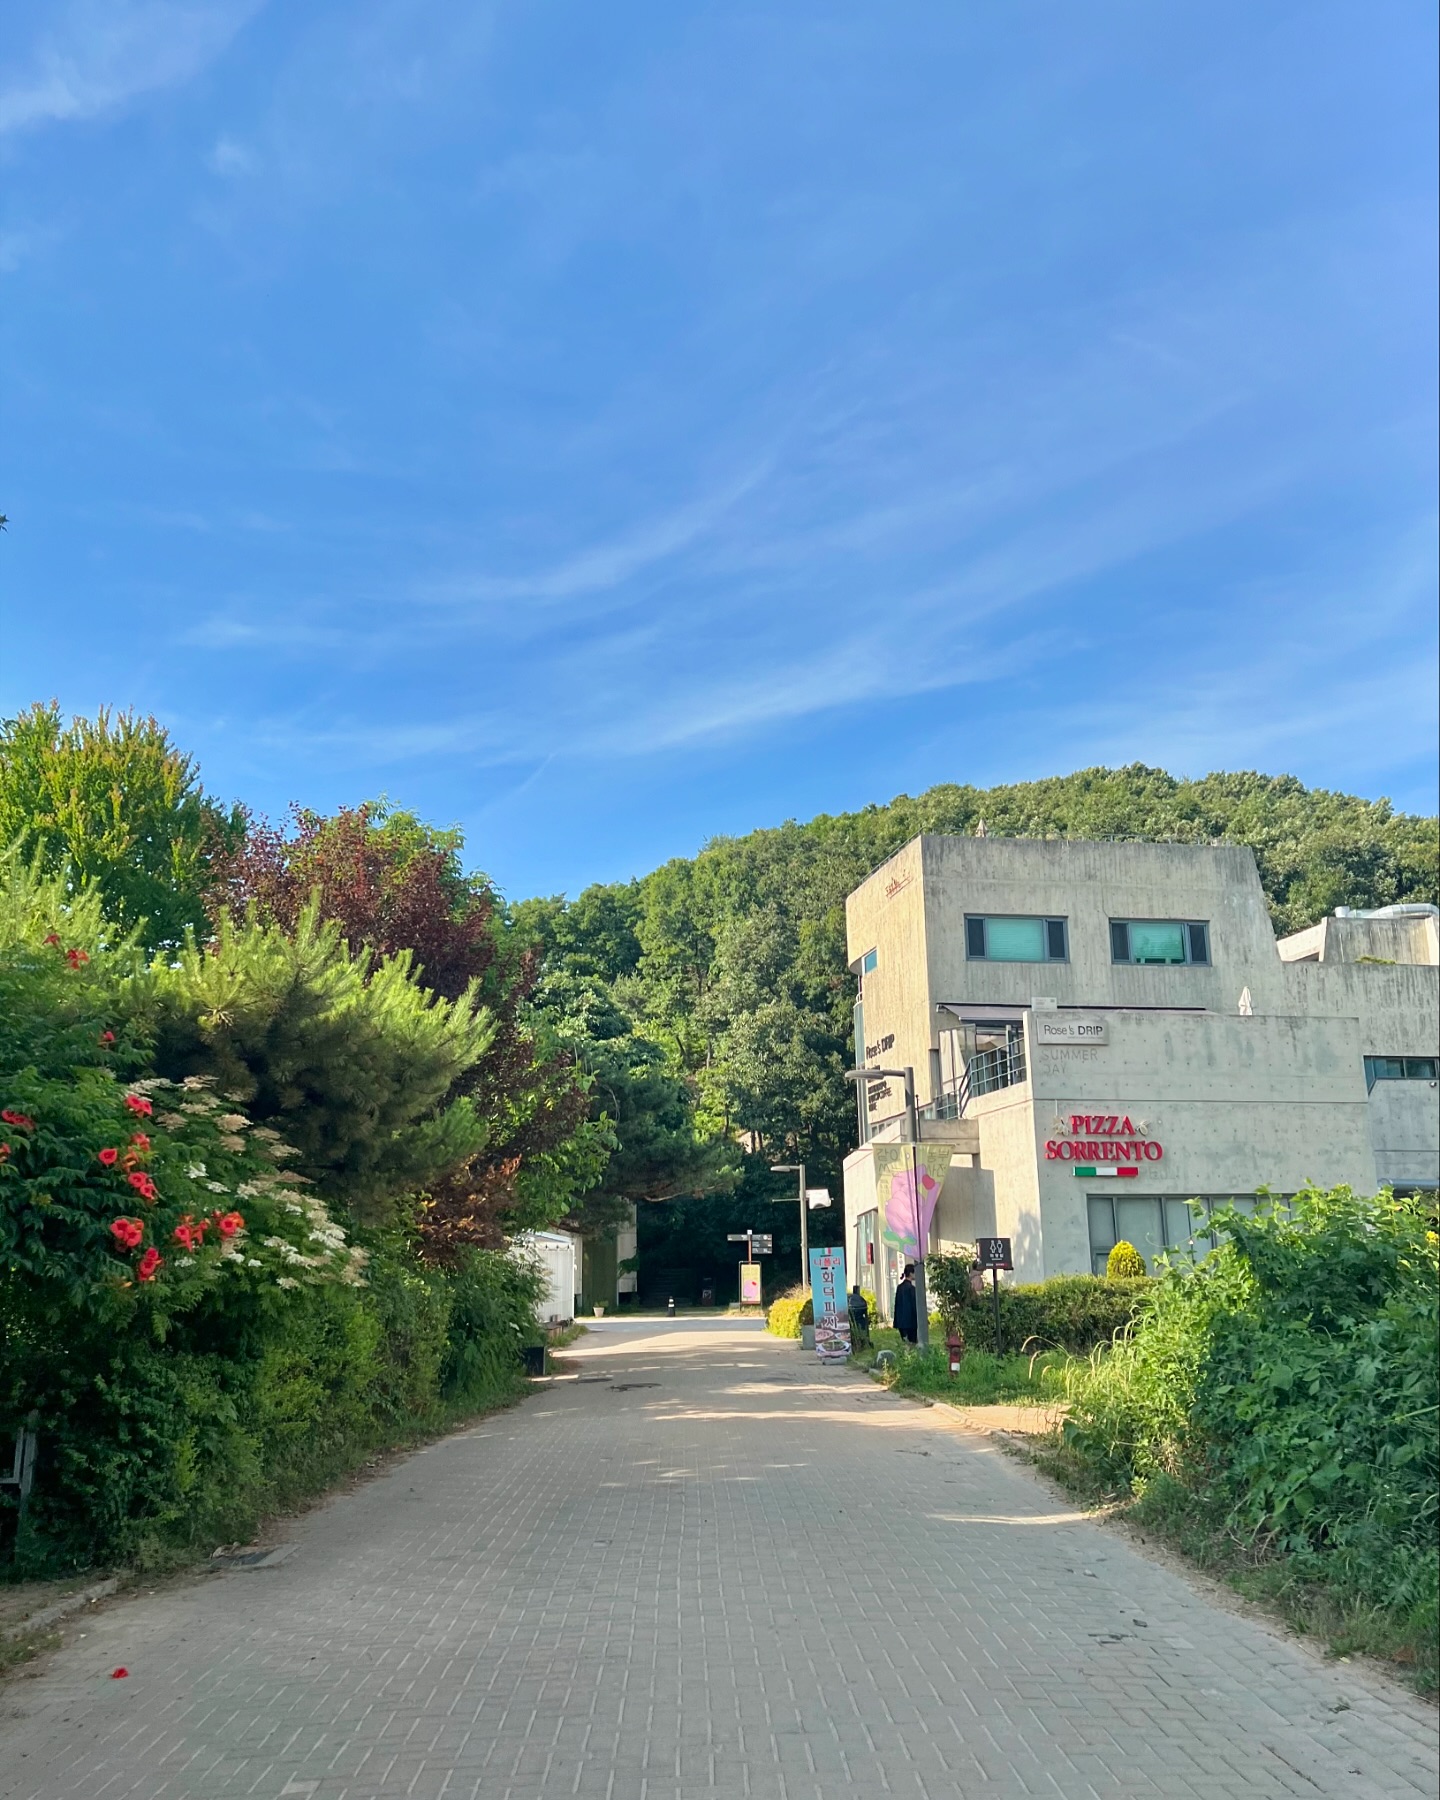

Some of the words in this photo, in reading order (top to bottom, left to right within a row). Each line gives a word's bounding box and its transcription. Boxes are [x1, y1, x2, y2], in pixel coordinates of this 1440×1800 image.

[1044, 1024, 1075, 1035] Rose's
[1078, 1025, 1103, 1035] DRIP
[1041, 1048, 1098, 1061] SUMMER
[1070, 1115, 1136, 1135] PIZZA
[1044, 1140, 1163, 1160] SORRENTO
[822, 1271, 839, 1329] 화덕피자
